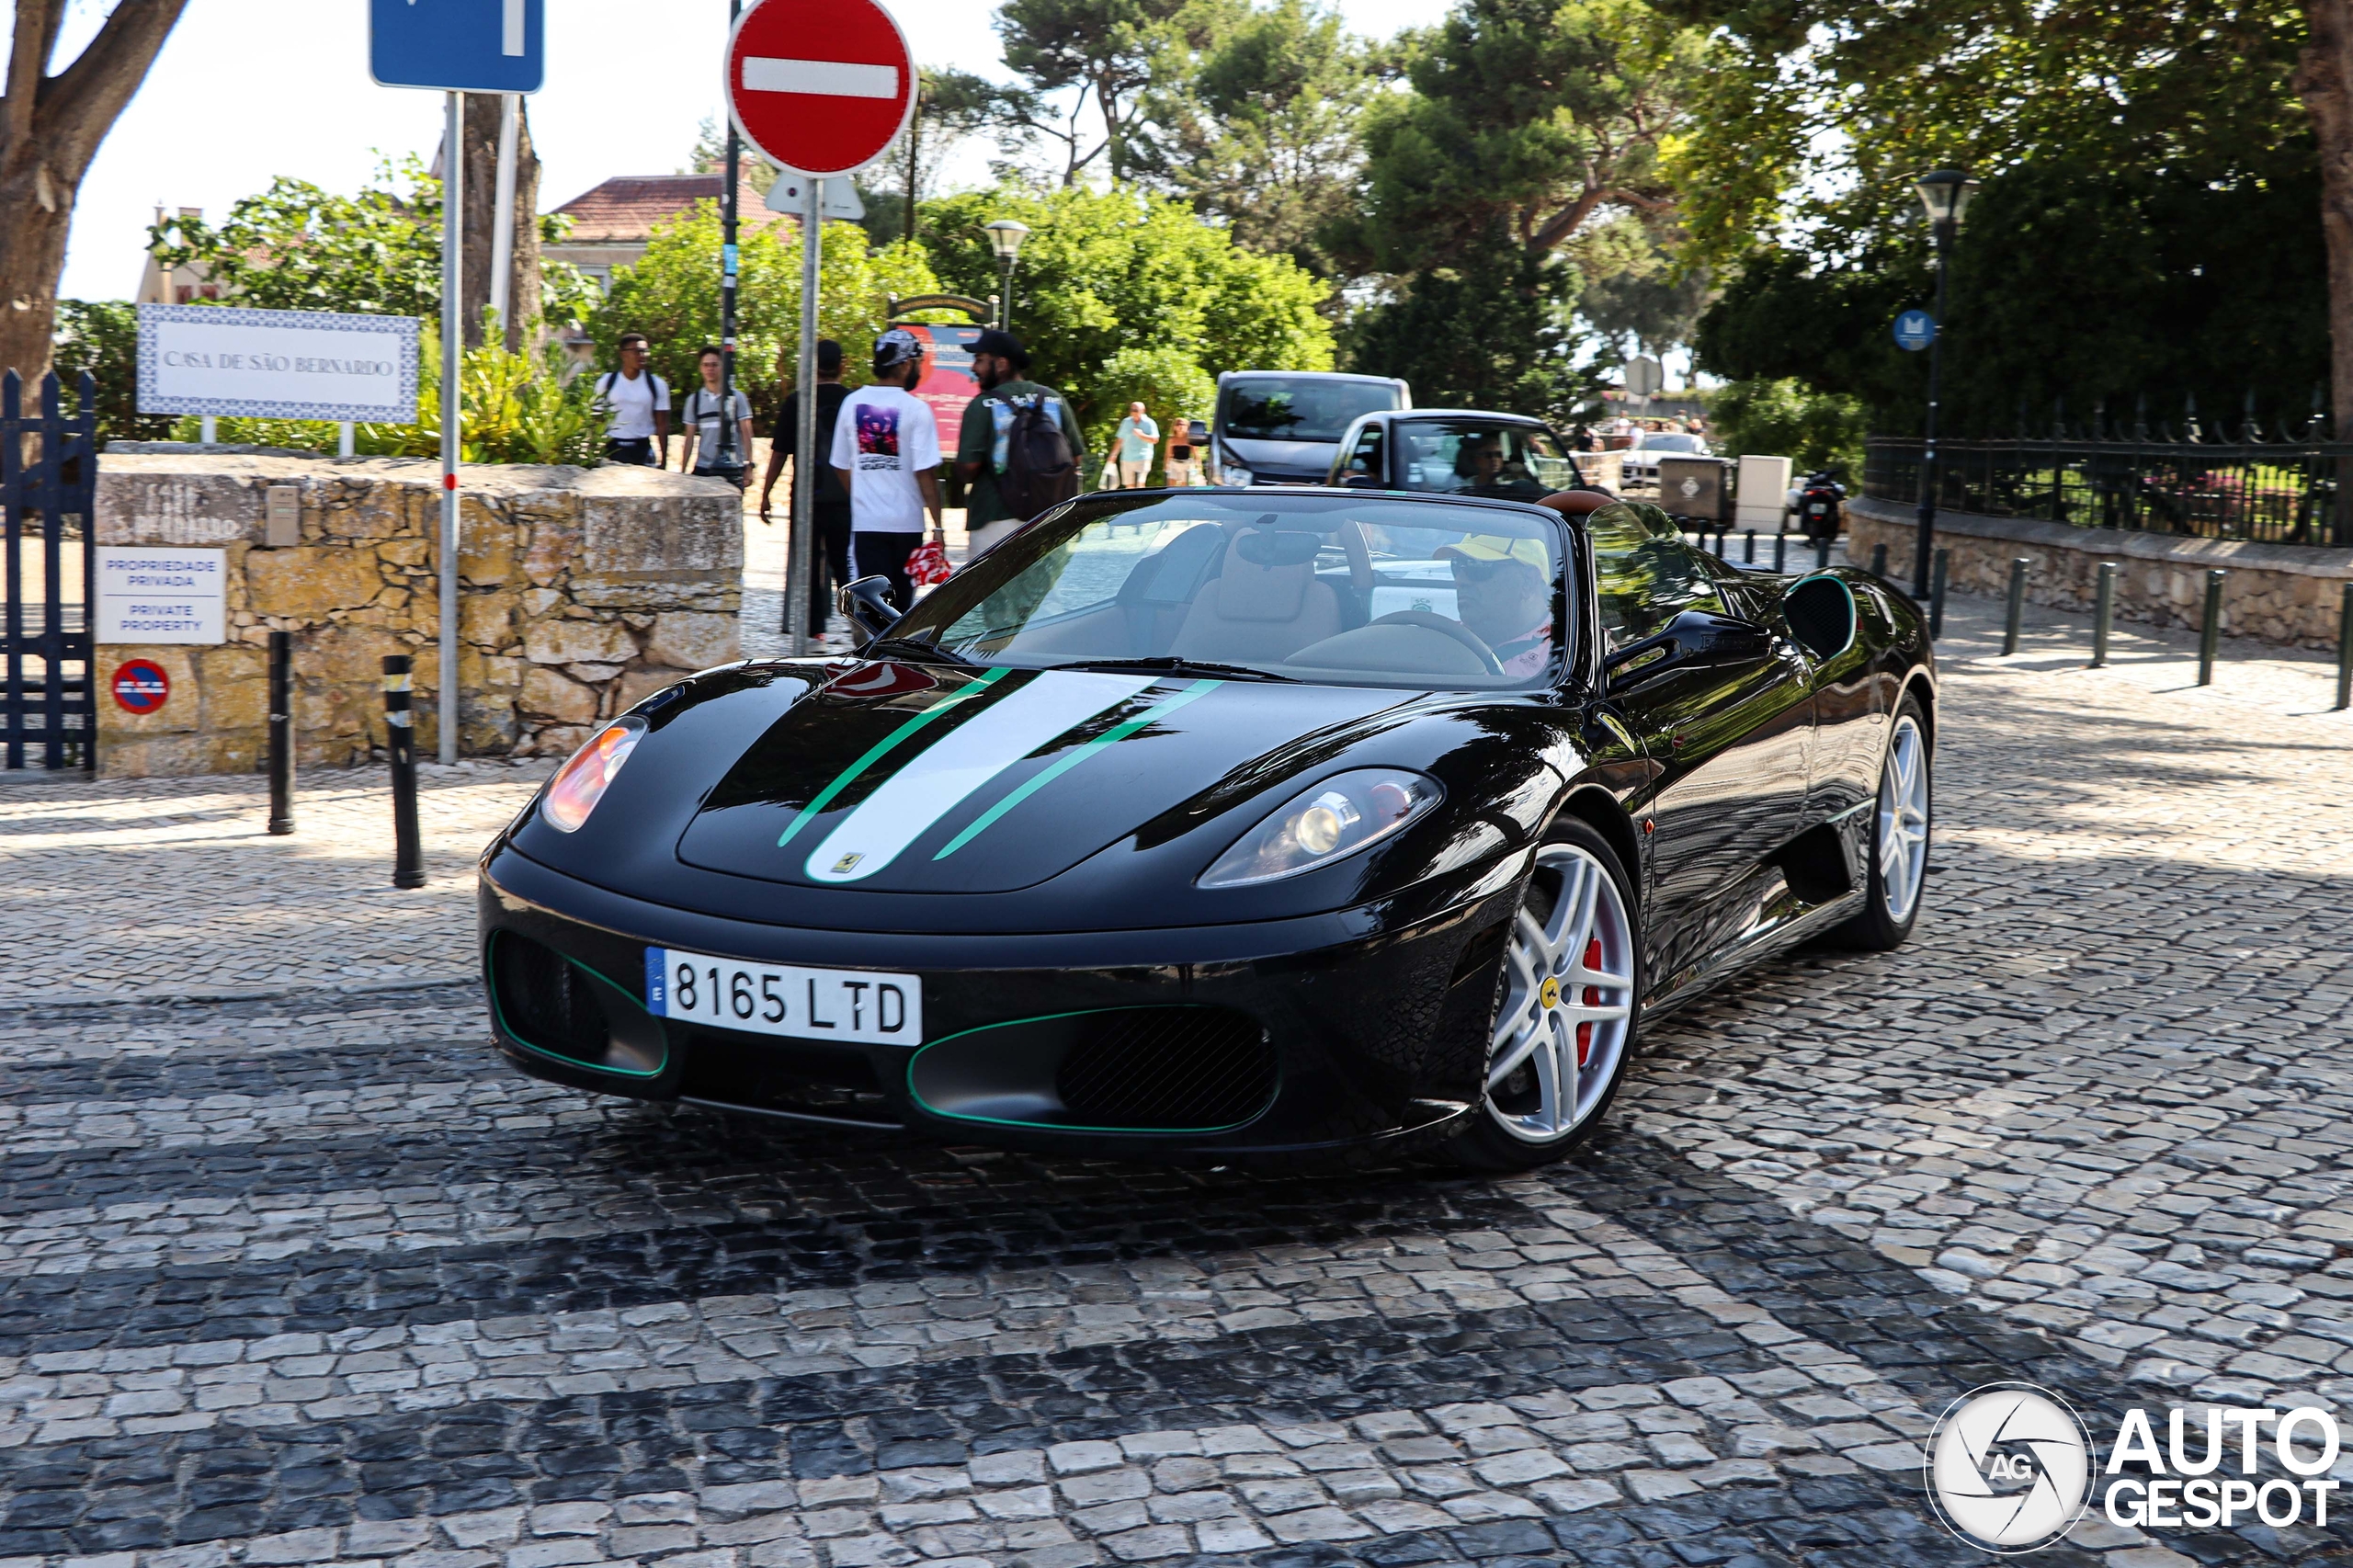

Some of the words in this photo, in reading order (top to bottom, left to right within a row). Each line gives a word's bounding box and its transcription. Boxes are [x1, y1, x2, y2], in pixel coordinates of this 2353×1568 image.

[164, 350, 211, 369] CASA
[219, 353, 244, 369] DE
[249, 352, 290, 372] SÃO
[295, 356, 394, 377] BERNARDO
[106, 560, 217, 572] PROPRIEDADE
[127, 575, 196, 586] PRIVADA
[129, 605, 194, 616] PRIVATE
[119, 619, 203, 631] PROPERTY
[652, 986, 664, 1002] E
[677, 962, 787, 1024] 8165
[807, 978, 906, 1034] LTD
